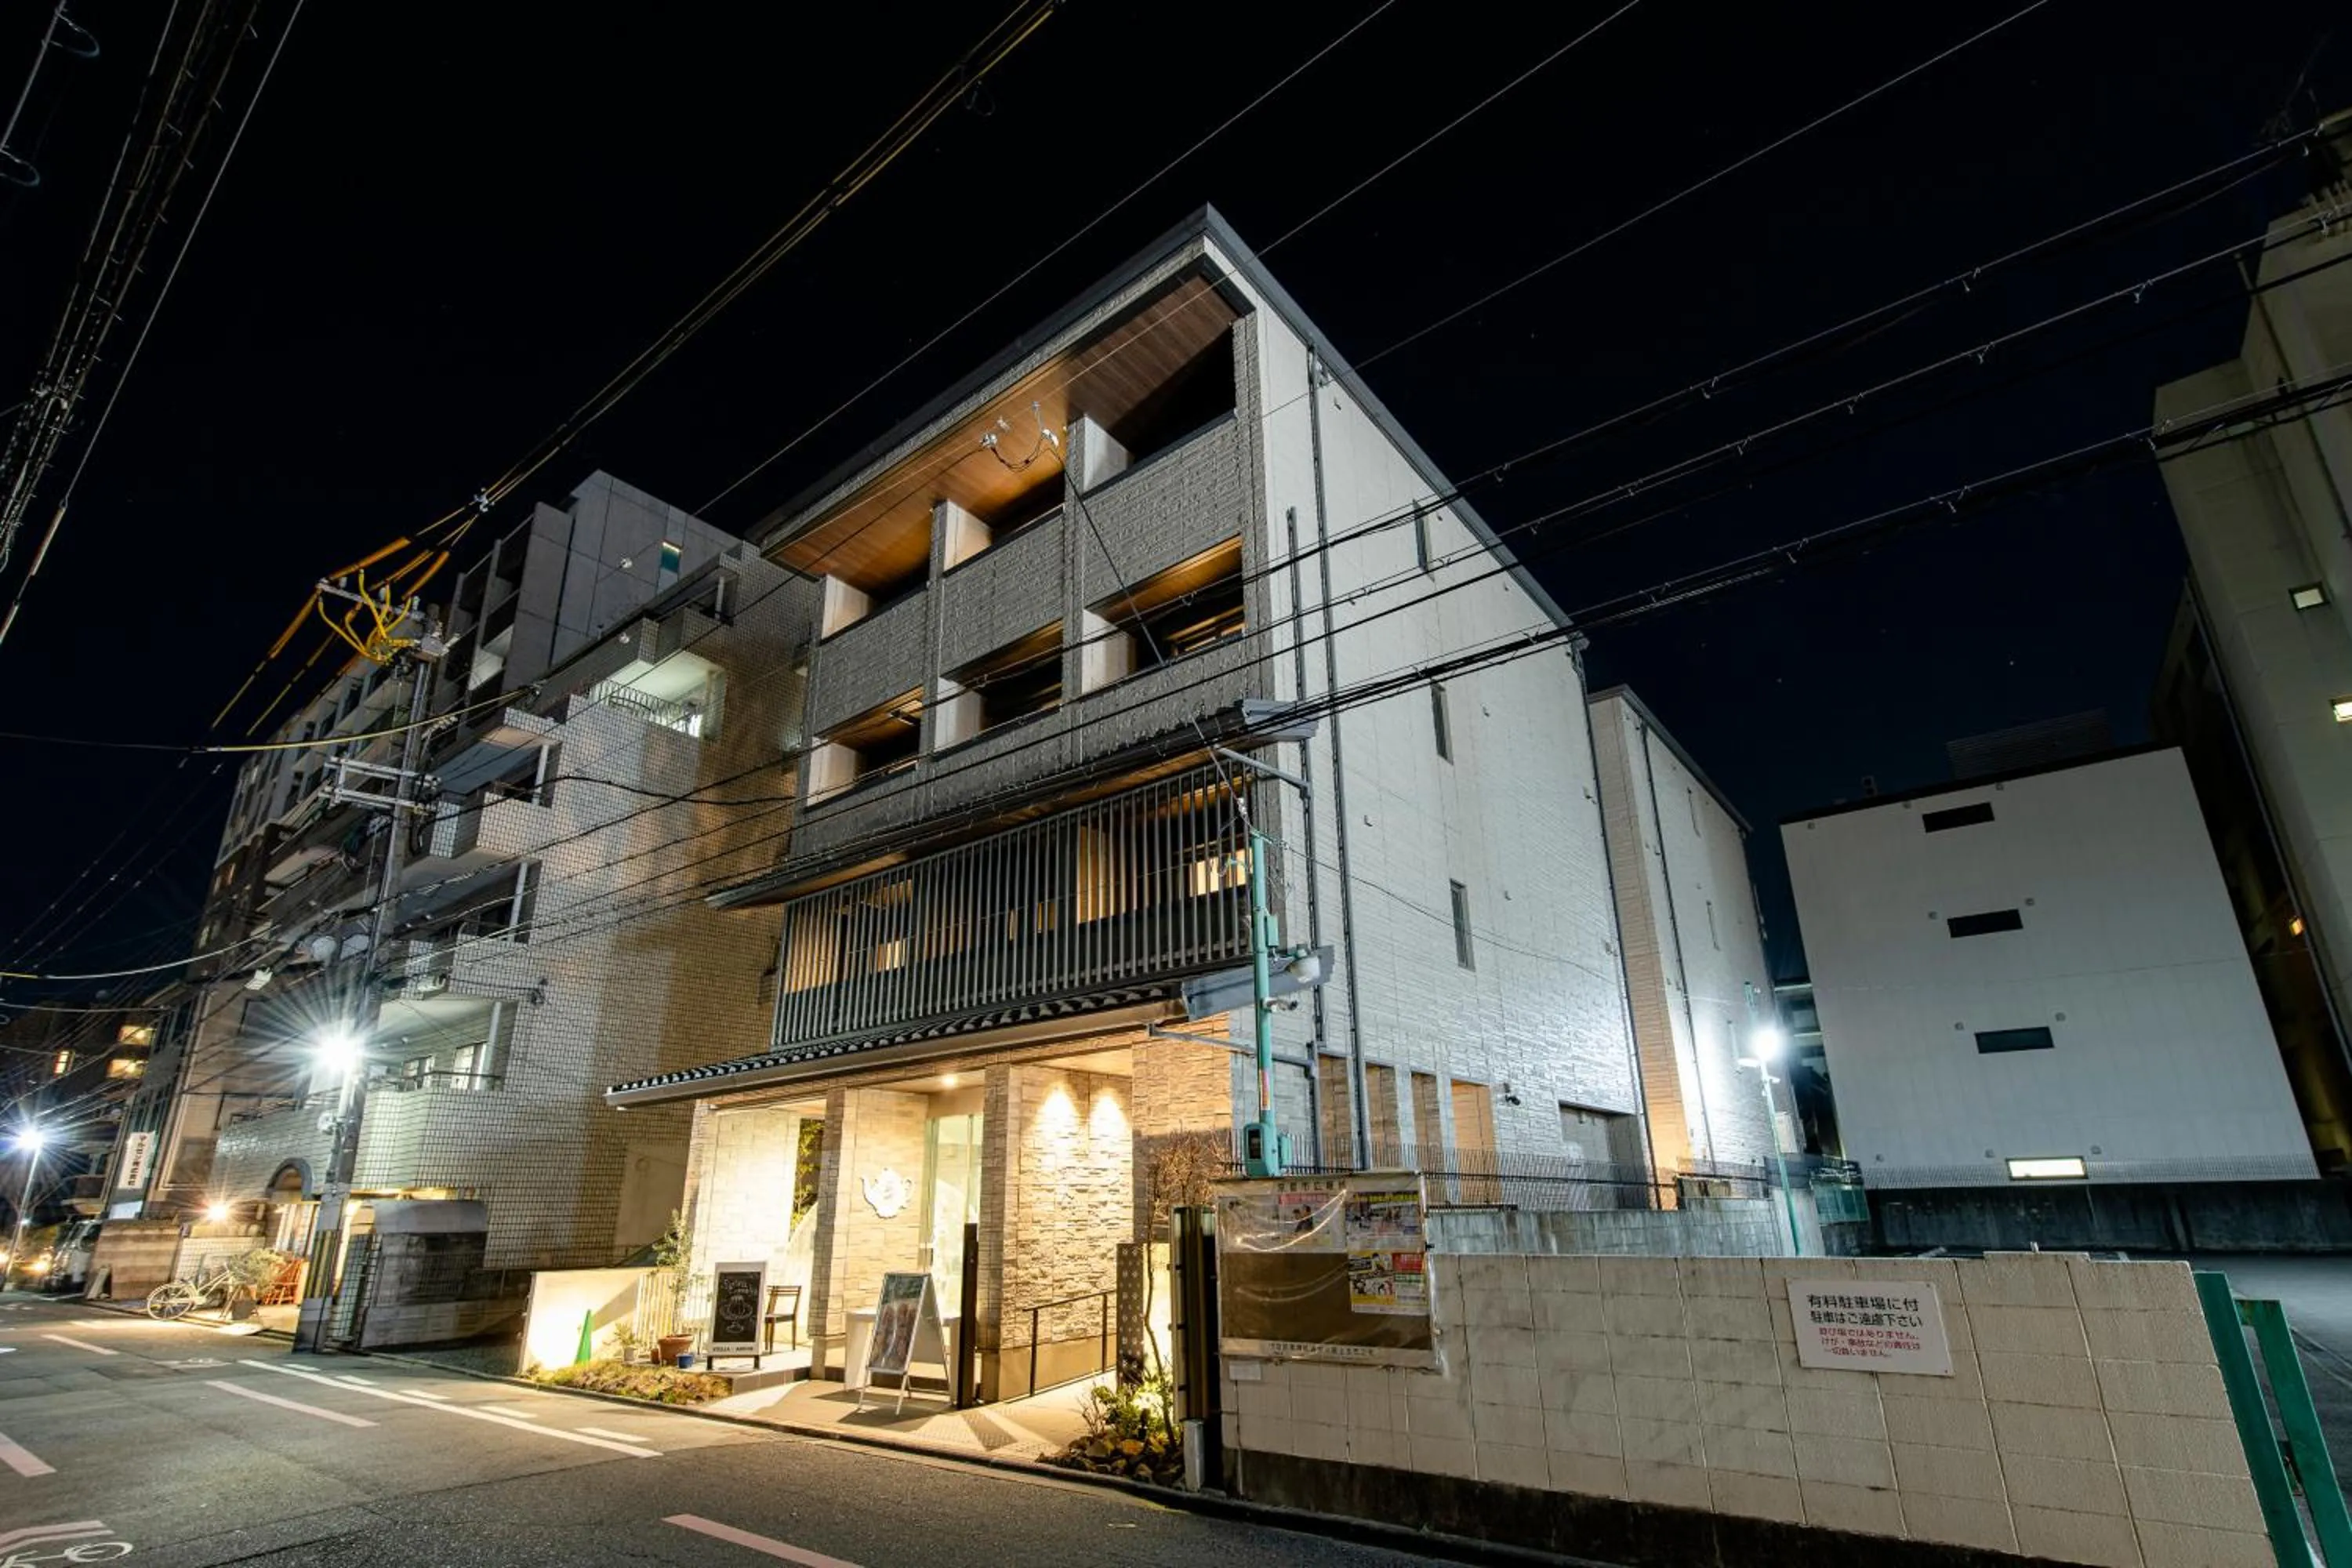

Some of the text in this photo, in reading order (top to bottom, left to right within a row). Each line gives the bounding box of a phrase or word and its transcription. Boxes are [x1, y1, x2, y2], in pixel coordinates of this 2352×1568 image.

[1806, 1294, 1919, 1312] 有料駐車場に付
[1809, 1311, 1923, 1327] 駐車はご遠慮下さい
